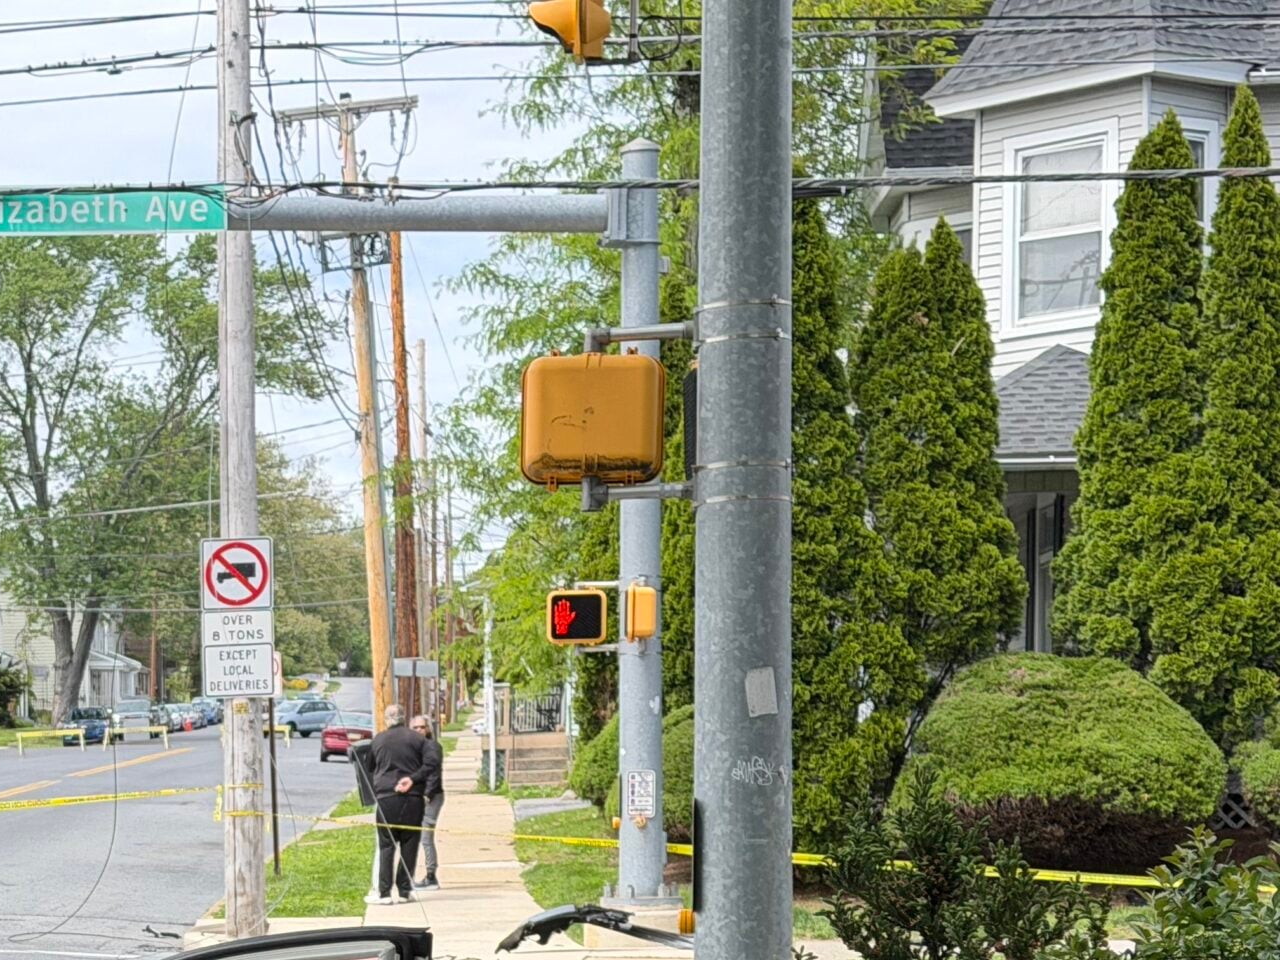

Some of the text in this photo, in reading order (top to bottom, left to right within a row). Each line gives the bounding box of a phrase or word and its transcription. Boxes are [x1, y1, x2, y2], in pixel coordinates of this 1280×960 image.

[145, 195, 209, 223] Ave
[222, 614, 253, 626] OVER
[212, 628, 265, 641] 8 TONS
[219, 649, 257, 661] EXCEPT
[223, 664, 254, 676] LOCAL
[209, 679, 269, 692] DELIVERIES
